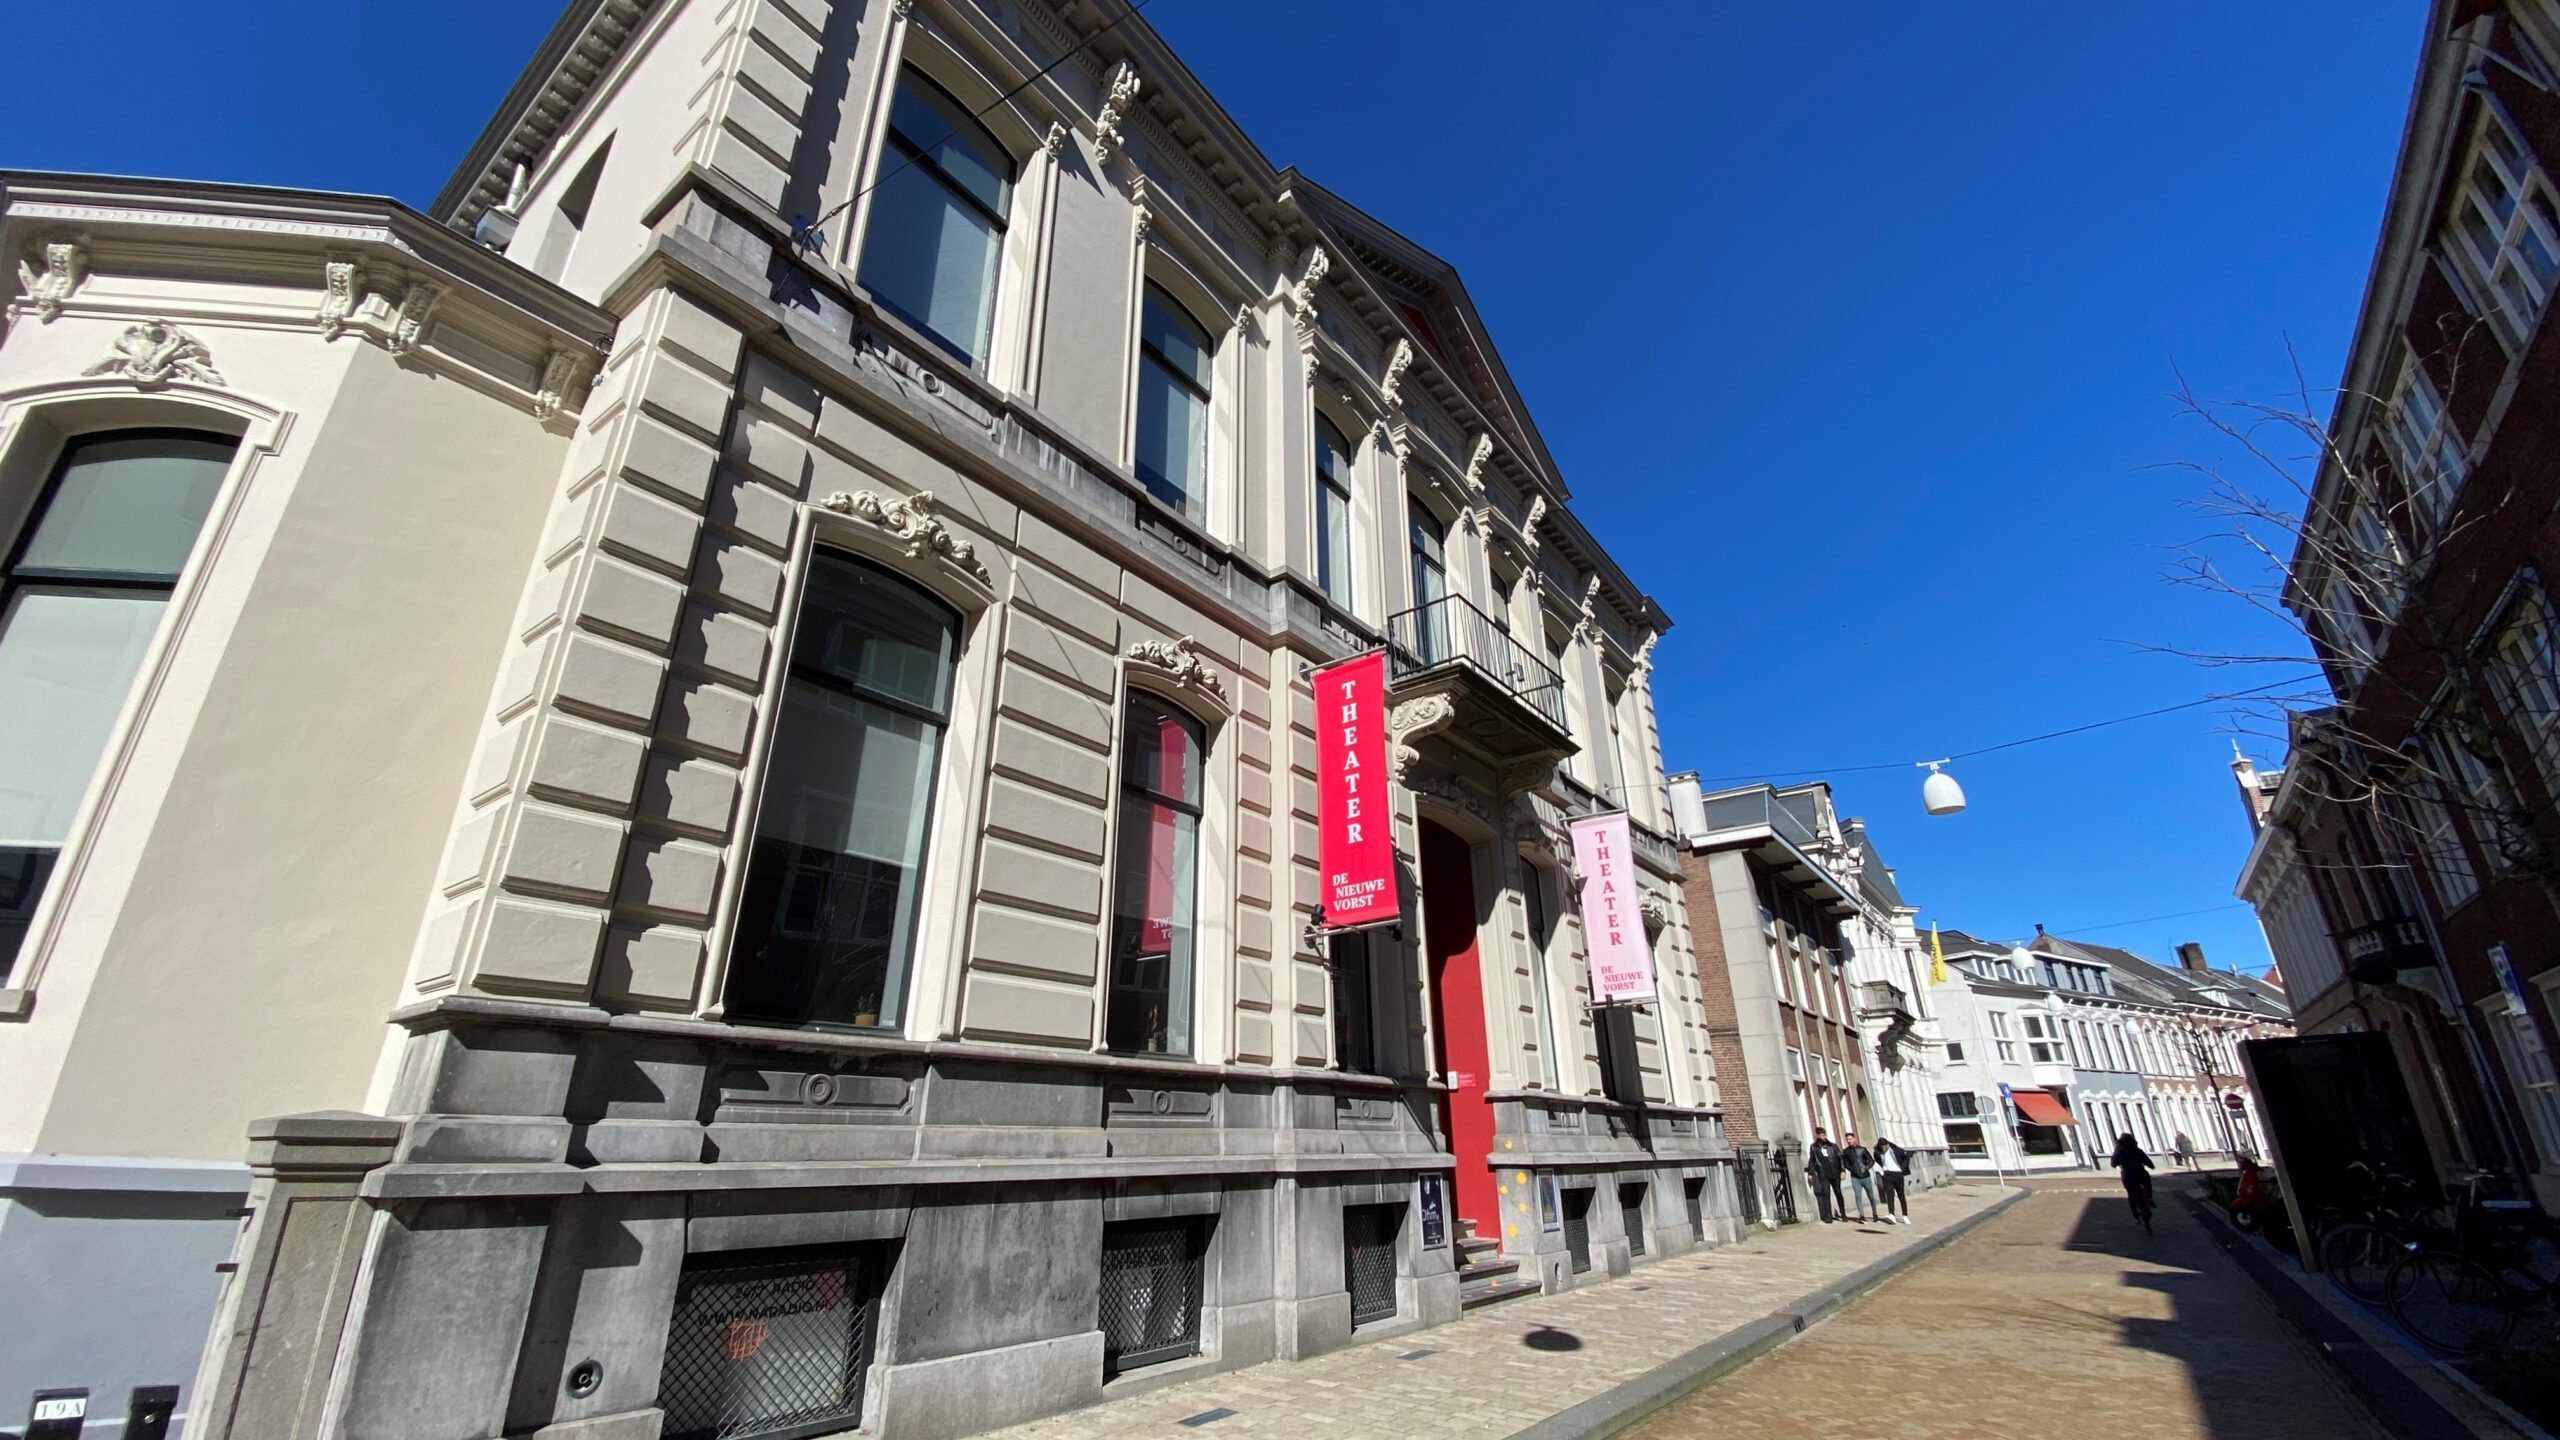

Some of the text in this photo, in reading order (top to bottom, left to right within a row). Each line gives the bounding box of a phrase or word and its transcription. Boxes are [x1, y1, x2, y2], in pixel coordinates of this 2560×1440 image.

[1341, 680, 1364, 845] THEATER
[1332, 873, 1349, 887] DE
[1335, 878, 1386, 898] NIEUWE
[1595, 830, 1623, 946] THEATER
[1333, 895, 1374, 912] VORST
[1601, 965, 1614, 975] DE
[1604, 971, 1644, 983] NIEUWE
[1603, 981, 1636, 992] VORST
[773, 1279, 816, 1294] RADIO
[41, 1402, 81, 1417] 19A
